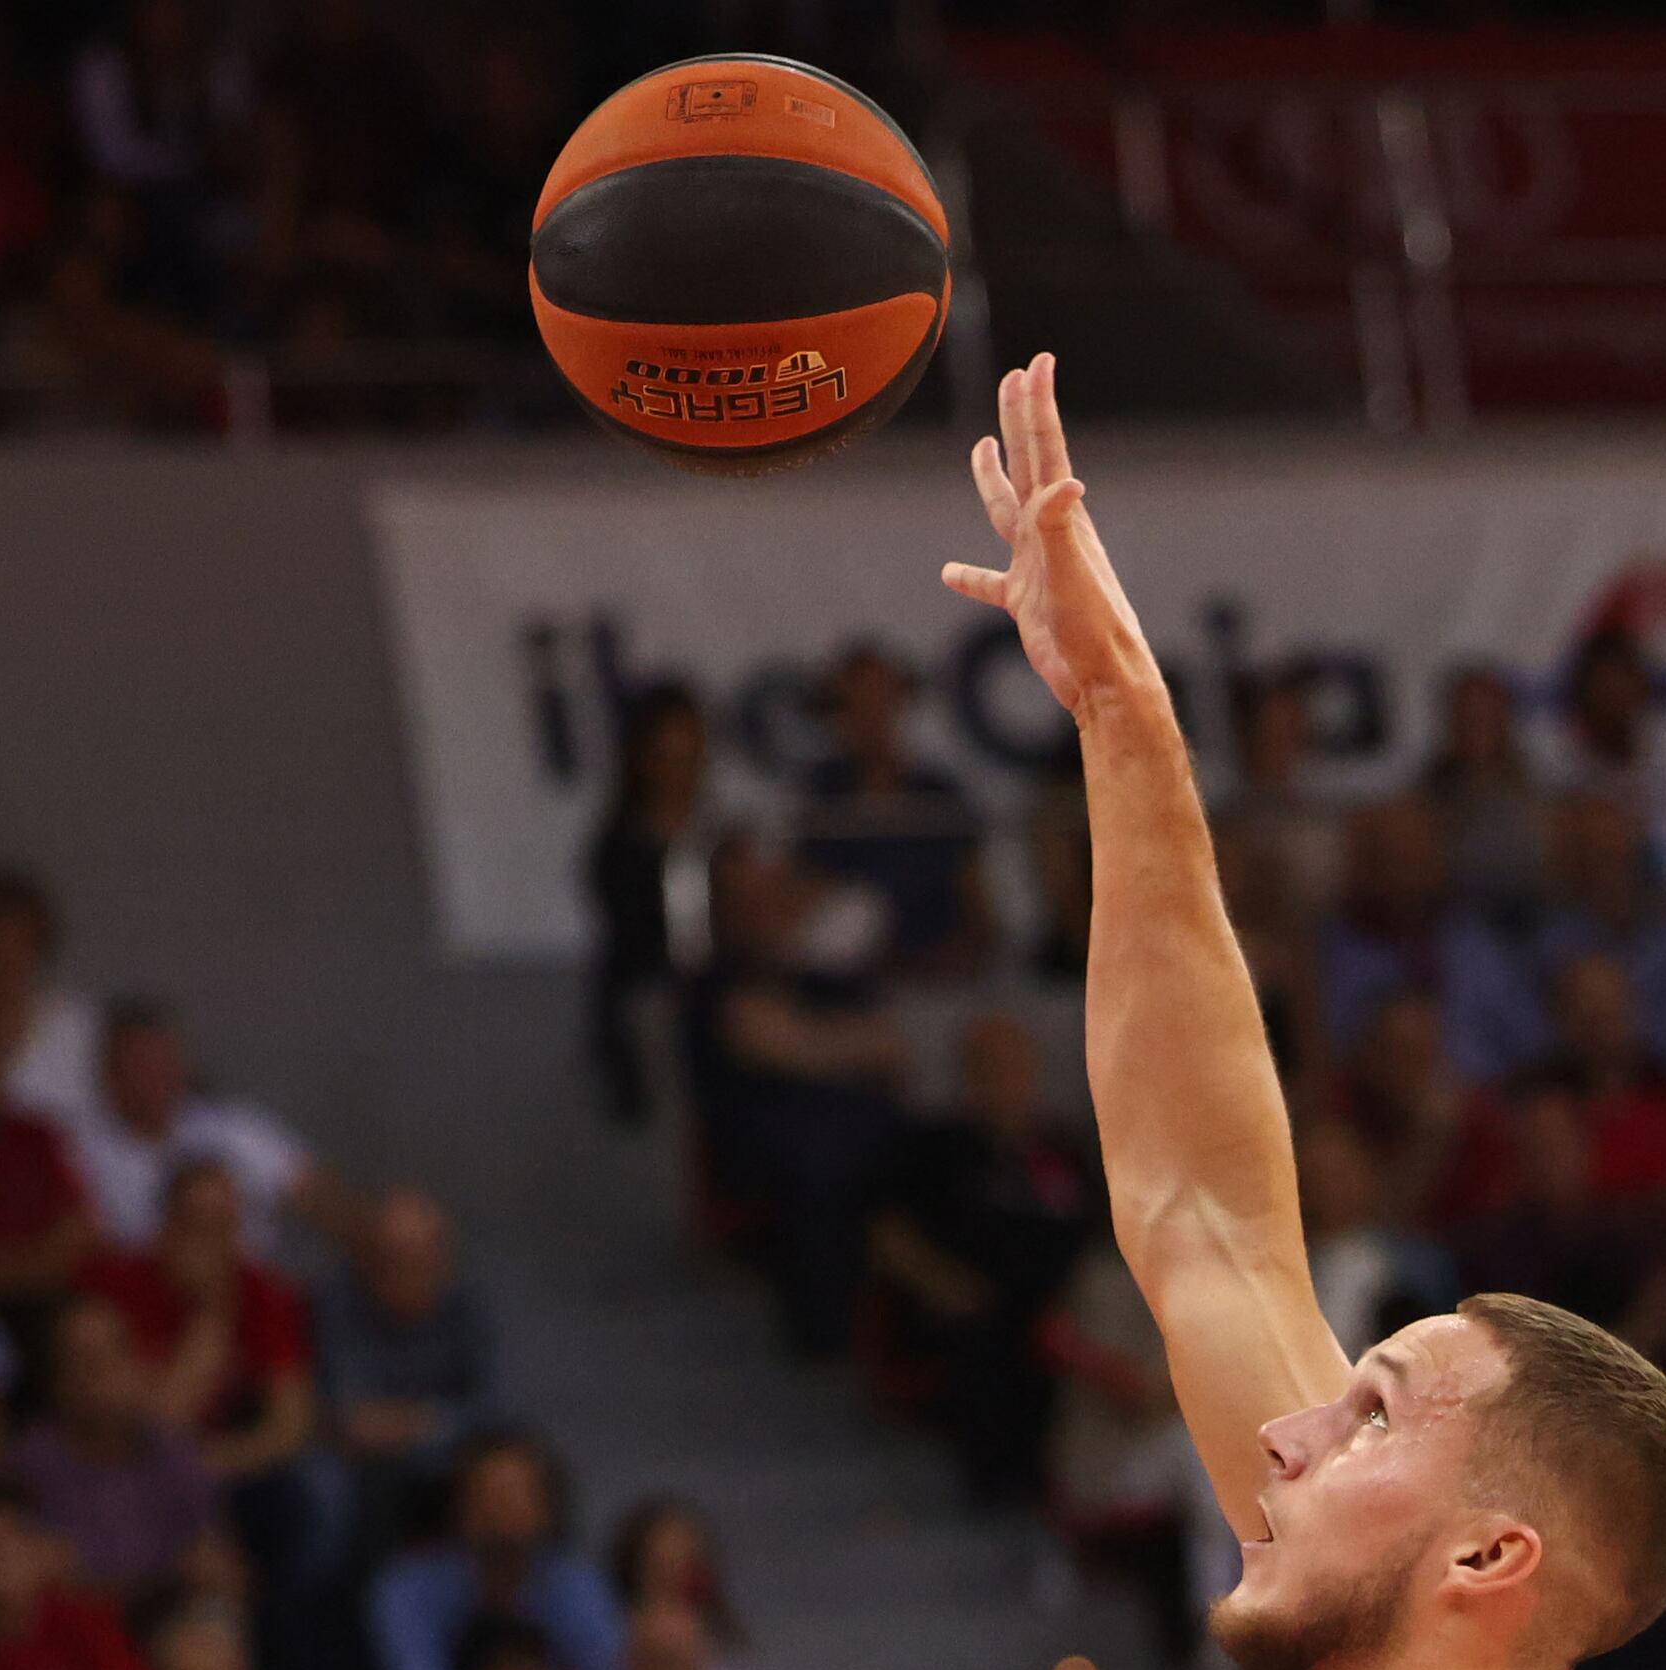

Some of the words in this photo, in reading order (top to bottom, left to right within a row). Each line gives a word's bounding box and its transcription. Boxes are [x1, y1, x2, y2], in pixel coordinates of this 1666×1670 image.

[659, 347, 688, 360] BALL
[692, 349, 724, 361] GAME
[727, 344, 783, 361] OFFICIAL
[625, 359, 769, 388] 1000
[611, 367, 848, 425] LEGACY
